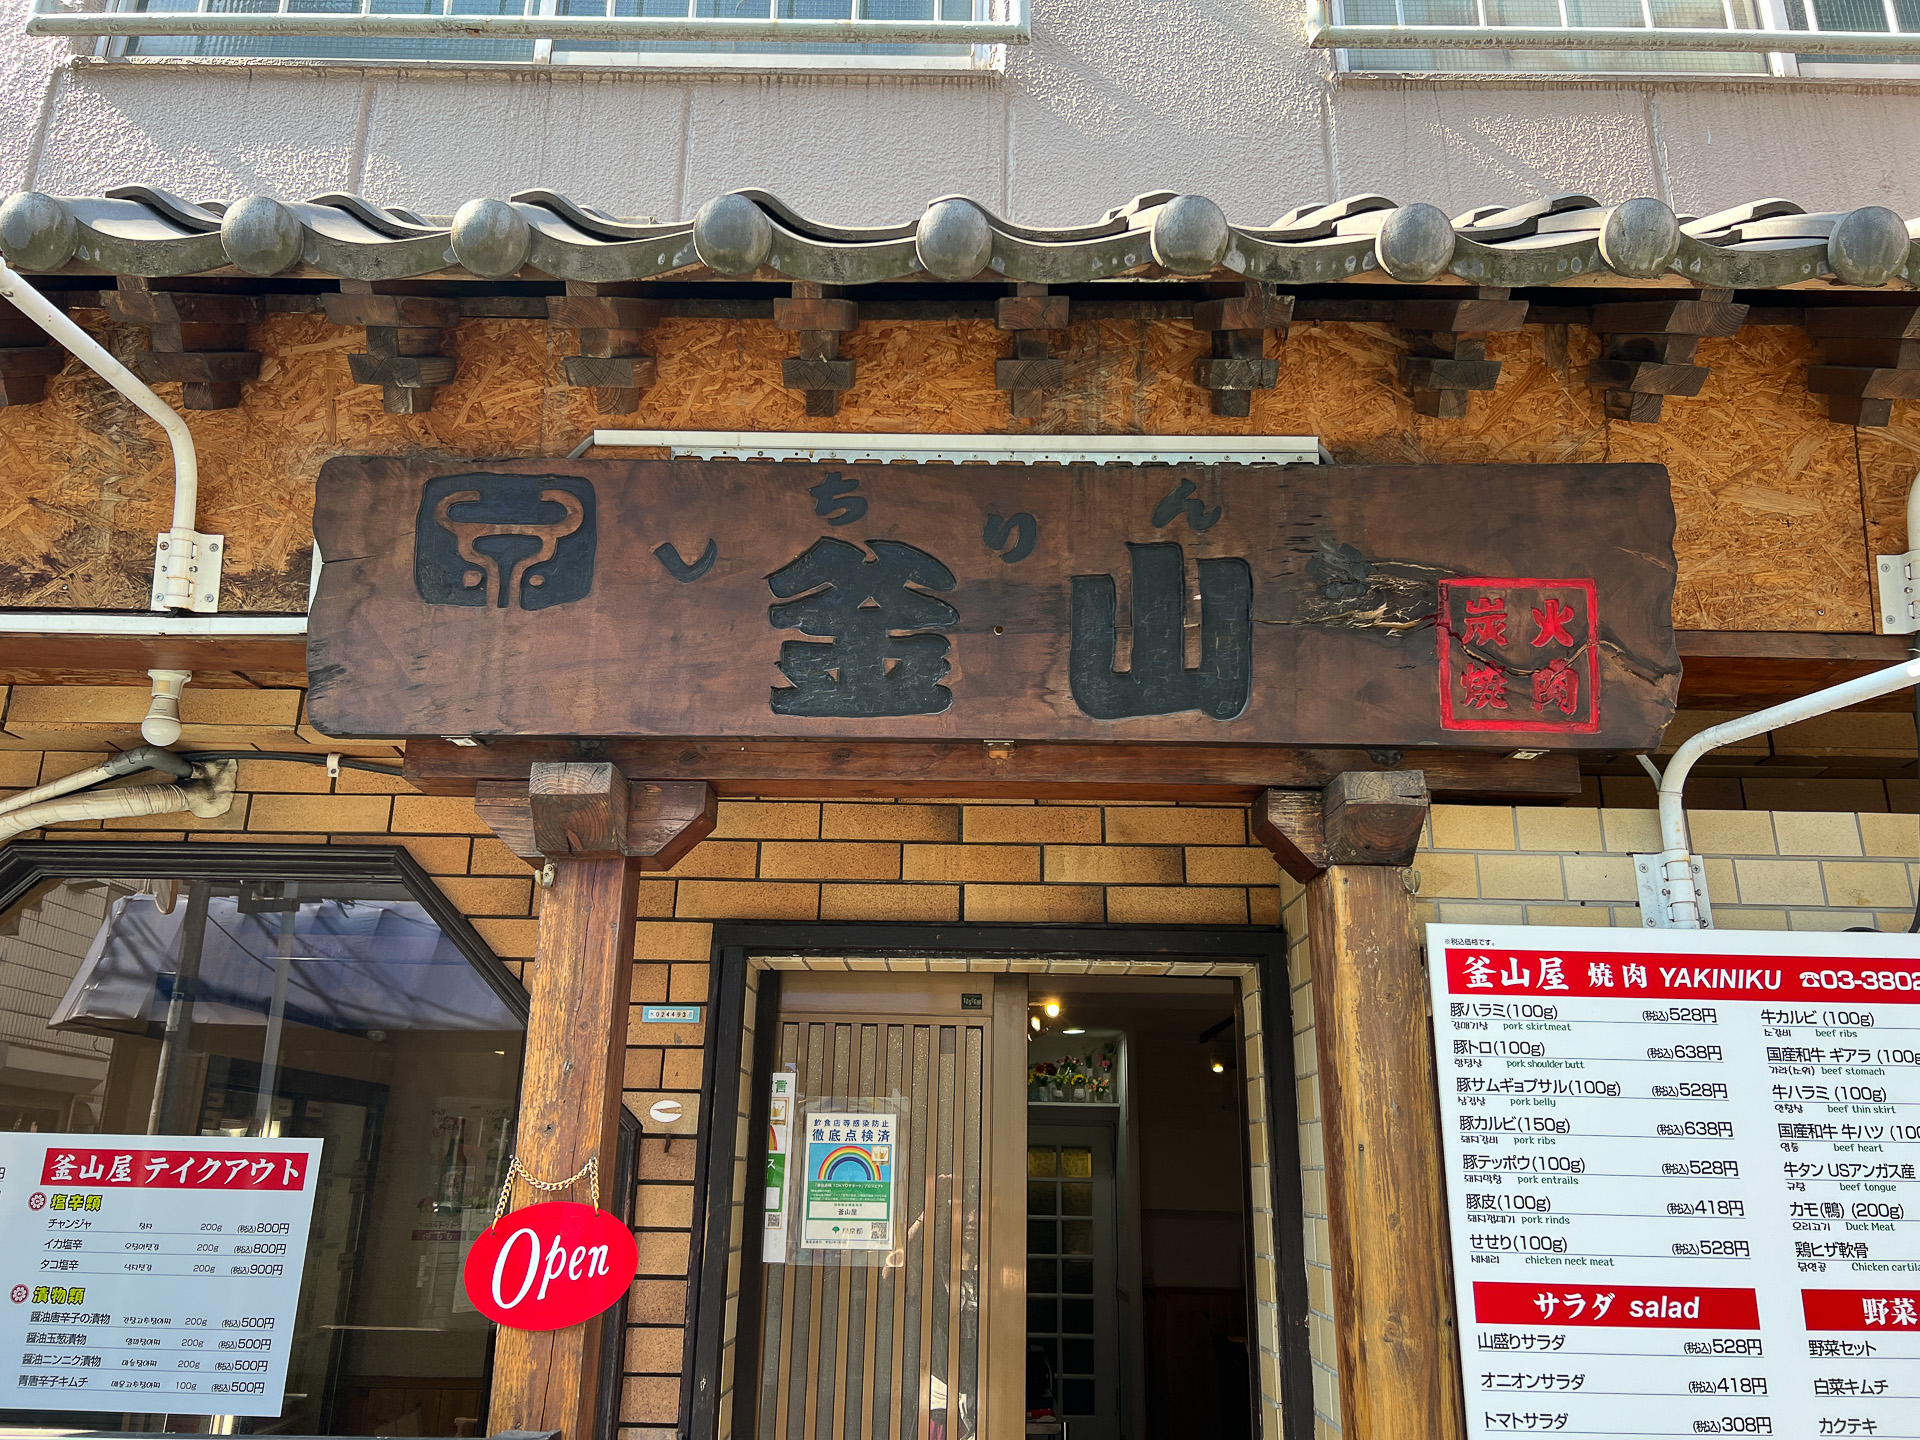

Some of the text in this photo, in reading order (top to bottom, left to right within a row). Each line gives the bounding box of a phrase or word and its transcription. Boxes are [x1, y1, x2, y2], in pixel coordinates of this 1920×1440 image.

[767, 534, 1252, 721] 釜山
[1461, 597, 1574, 647] 炭火
[1461, 659, 1580, 713] 焼肉
[1462, 955, 1569, 991] 釜山屋
[1587, 962, 1648, 988] 焼肉
[1659, 967, 1782, 990] YAKINIKU
[1450, 1002, 1717, 1023] 豚ハラミ(100g) (税込)528円
[1761, 1009, 1875, 1027] 牛カルビ (100g)
[1503, 1023, 1572, 1031] pork skirtmeat
[1815, 1028, 1858, 1038] beef ribs
[1453, 1039, 1723, 1061] 豚トロ(100g) (税込)638円
[1766, 1046, 1826, 1062] 国産和牛
[1829, 1047, 1871, 1063] ギアラ
[1506, 1060, 1585, 1069] pork shoulder butt
[1821, 1066, 1885, 1075] beef stomach
[1456, 1077, 1728, 1098] 豚サムギョプサル(100g) (税込)528円
[1772, 1084, 1887, 1102] 牛ハラミ (100g)
[1510, 1098, 1556, 1107] pork belly
[1827, 1105, 1896, 1114] beef thin skirt
[1459, 1115, 1734, 1137] 豚カルビ(150g) (税込)638円
[1778, 1123, 1838, 1139] 国産和牛
[1841, 1124, 1883, 1139] 牛ハツ
[812, 1128, 890, 1142] 徹底点検済
[1513, 1136, 1556, 1145] pork ribs
[1833, 1143, 1884, 1152] beef heart
[50, 1154, 300, 1186] 釜山屋 テイクアウト
[1462, 1154, 1739, 1177] 豚テッポウ(100g) (税込)528円
[1783, 1161, 1916, 1179] 牛タン USアンガス産
[1517, 1175, 1579, 1185] pork entrails
[1839, 1182, 1897, 1192] beef tongue
[50, 1194, 102, 1212] 塩辛類
[1466, 1193, 1744, 1217] 豚皮(100g) (税込)418円
[1790, 1201, 1904, 1220] カモ(鴨) (200g)
[48, 1218, 92, 1230] チャンジャ
[200, 1223, 222, 1232] 200g
[237, 1223, 289, 1235] (税込)800円
[1521, 1215, 1570, 1225] pork rinds
[1845, 1222, 1895, 1231] Duck Meat
[44, 1239, 82, 1250] イカ塩辛
[196, 1243, 219, 1253] 200g
[234, 1243, 286, 1255] (税込)800円
[1469, 1233, 1750, 1257] せせり(100g) (税込)528円
[1795, 1241, 1869, 1259] 鶏ヒザ軟骨
[40, 1259, 79, 1271] タコ塩辛
[192, 1263, 215, 1274] 200g
[230, 1264, 283, 1276] (税込)900円
[491, 1228, 610, 1309] Open
[1525, 1256, 1615, 1266] chicken neck meat
[1851, 1262, 1889, 1272] Chicken
[32, 1286, 85, 1304] 漬物類
[1533, 1291, 1700, 1321] サラダ salad
[1862, 1297, 1918, 1325] 野菜
[184, 1318, 207, 1327] 200g
[221, 1317, 275, 1329] (税込)500円
[181, 1338, 204, 1348] 200g
[217, 1338, 271, 1351] (税込)500円
[1477, 1331, 1763, 1356] 山盛りサラダ (税込)528円
[1808, 1339, 1877, 1356] 野菜セット
[177, 1359, 200, 1369] 200g
[214, 1359, 268, 1372] (税込)500円
[18, 1375, 88, 1388] 青唐辛子キムチ
[175, 1381, 197, 1391] 100g
[211, 1381, 265, 1394] (税込)500円
[1480, 1372, 1767, 1395] オニオンサラダ (税込)418円
[1814, 1378, 1889, 1395] 白菜キムチ
[1484, 1411, 1773, 1434] トマトサラダ (税込)308円
[1818, 1417, 1878, 1434] カクテキ
